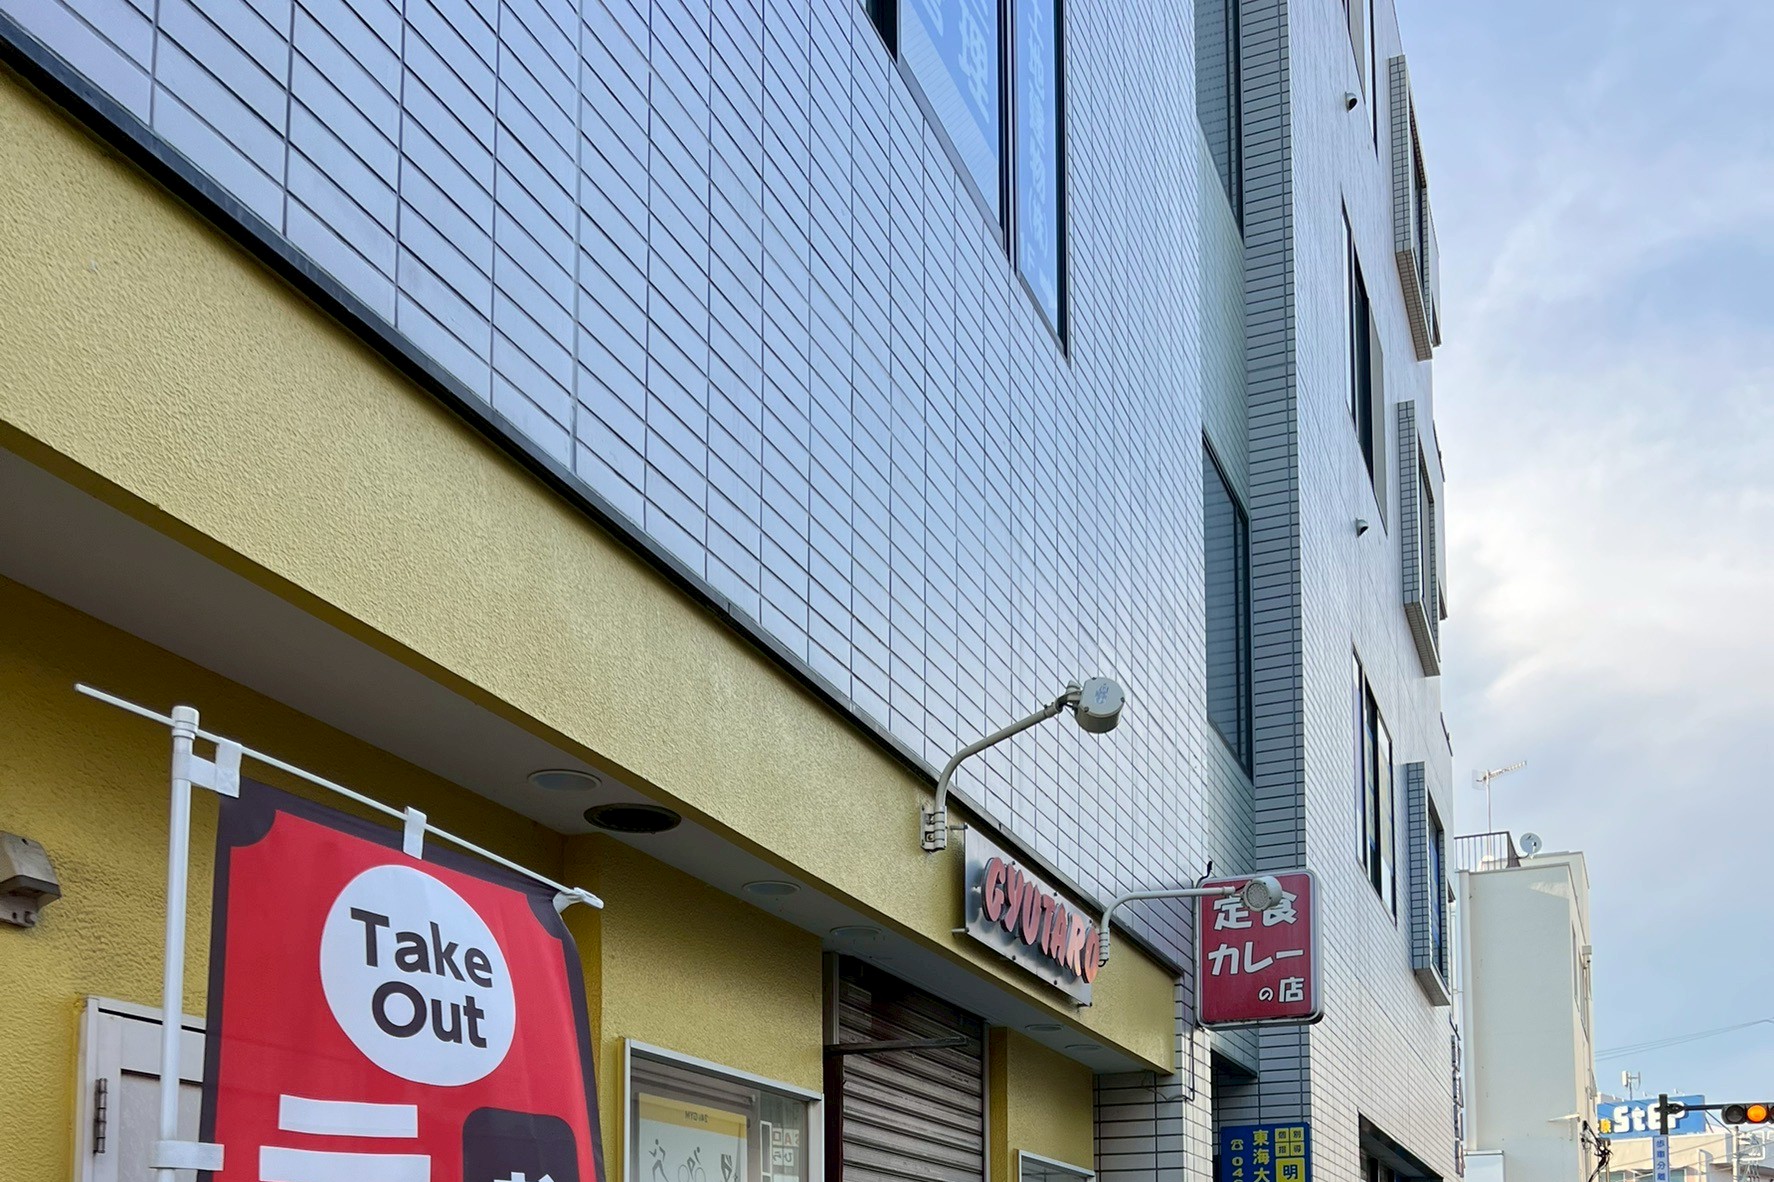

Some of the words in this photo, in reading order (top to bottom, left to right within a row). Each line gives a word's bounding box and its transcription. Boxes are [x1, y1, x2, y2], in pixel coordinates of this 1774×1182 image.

[350, 909, 493, 988] Take
[981, 857, 1100, 983] GYUTARO
[1208, 941, 1303, 976] カレー
[1258, 976, 1304, 1003] の店
[371, 983, 489, 1049] Out
